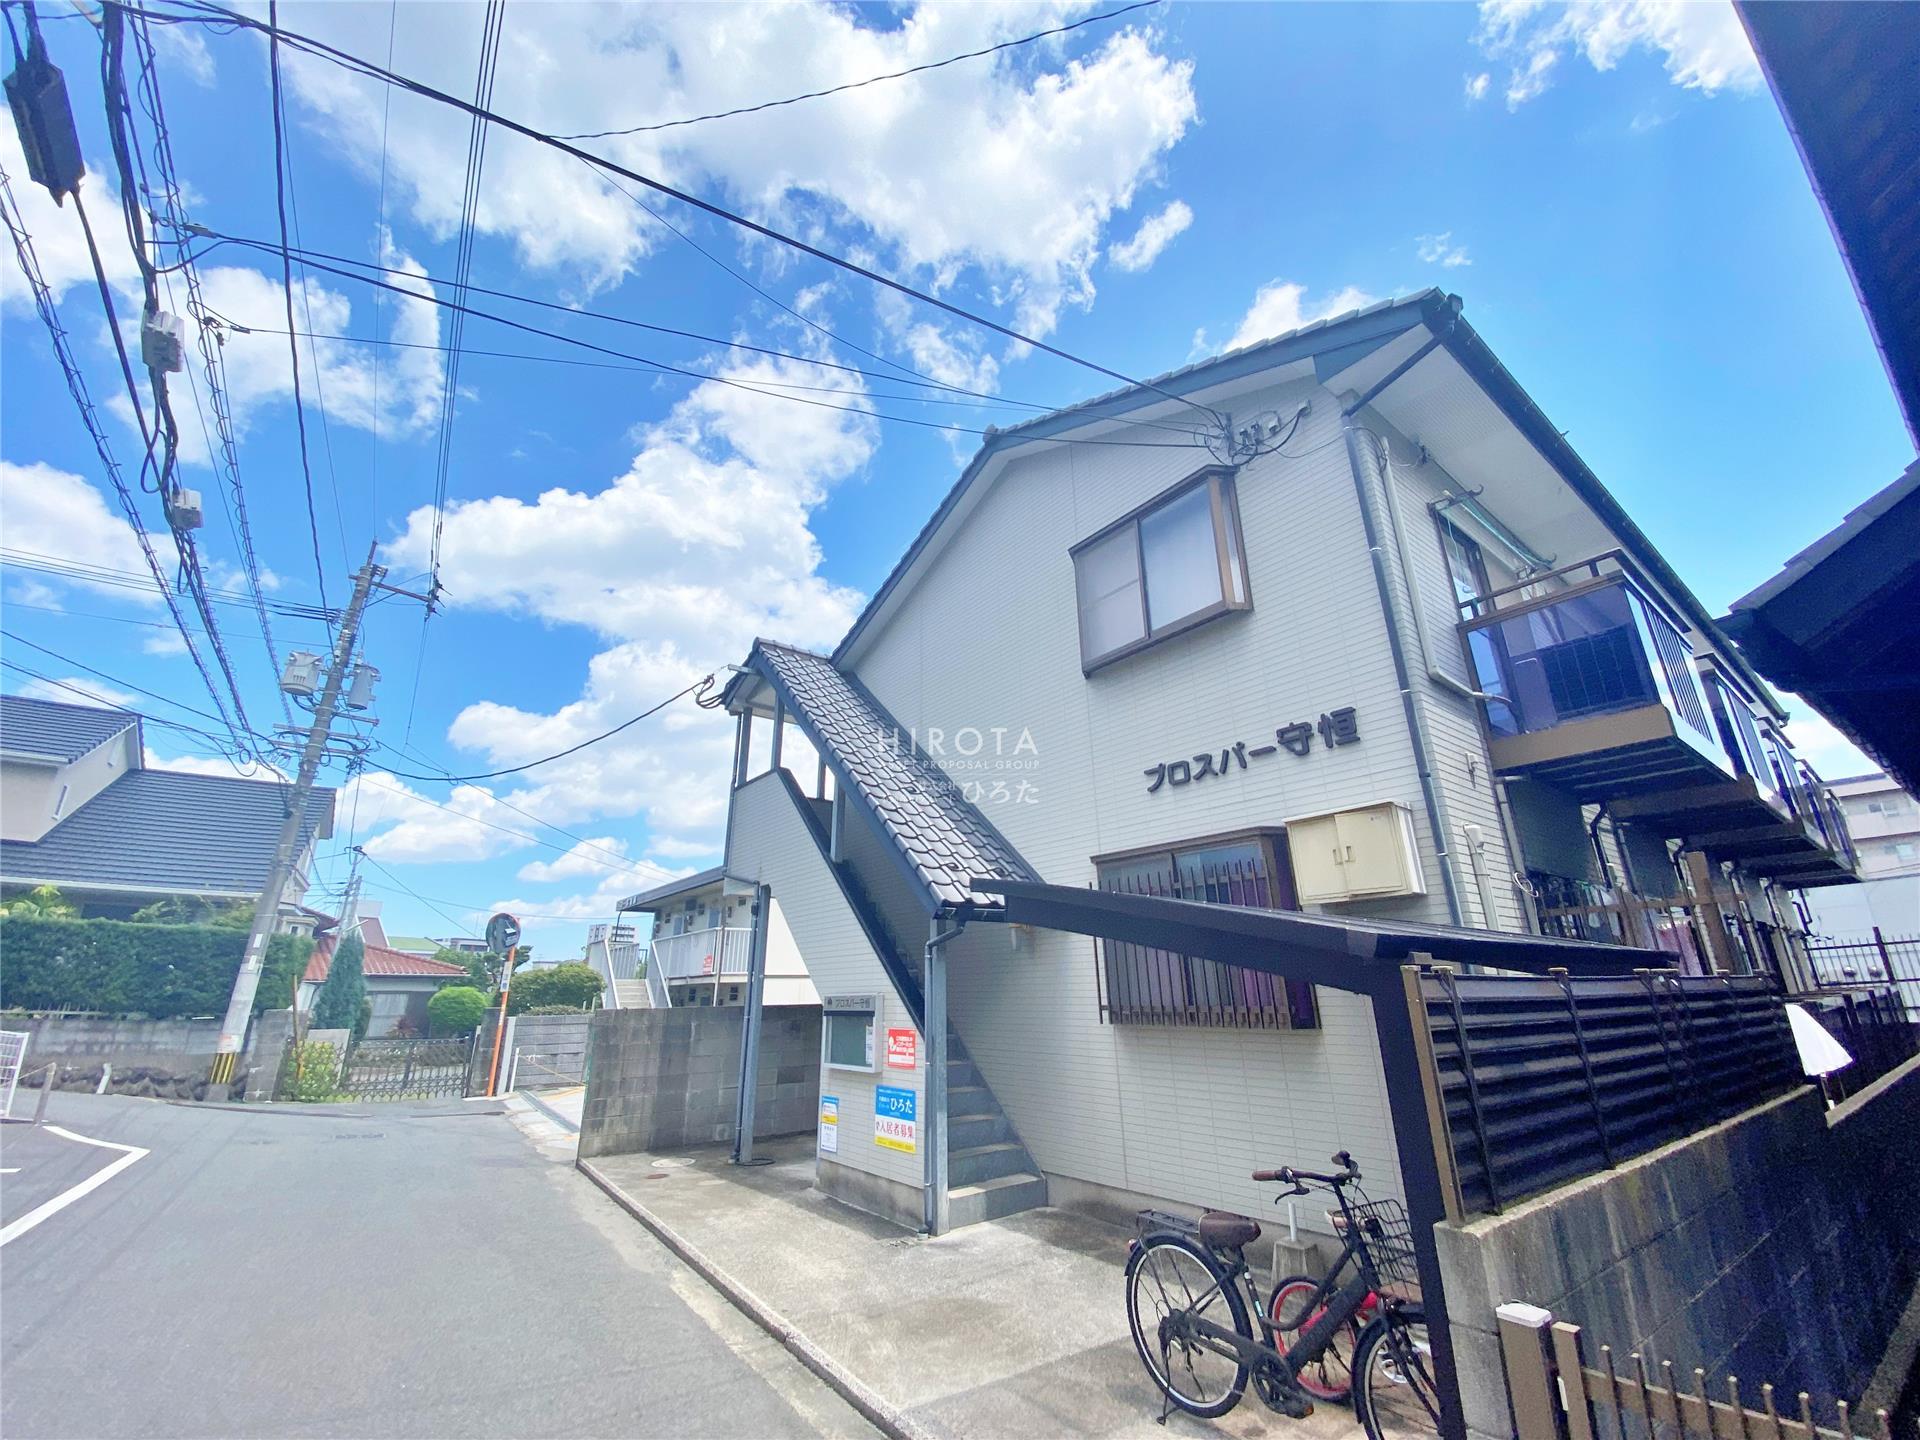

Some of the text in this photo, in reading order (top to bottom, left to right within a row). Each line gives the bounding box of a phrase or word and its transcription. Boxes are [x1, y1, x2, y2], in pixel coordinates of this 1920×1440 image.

[1144, 706, 1361, 793] プロスパー守恒
[890, 1098, 913, 1114] ひろた
